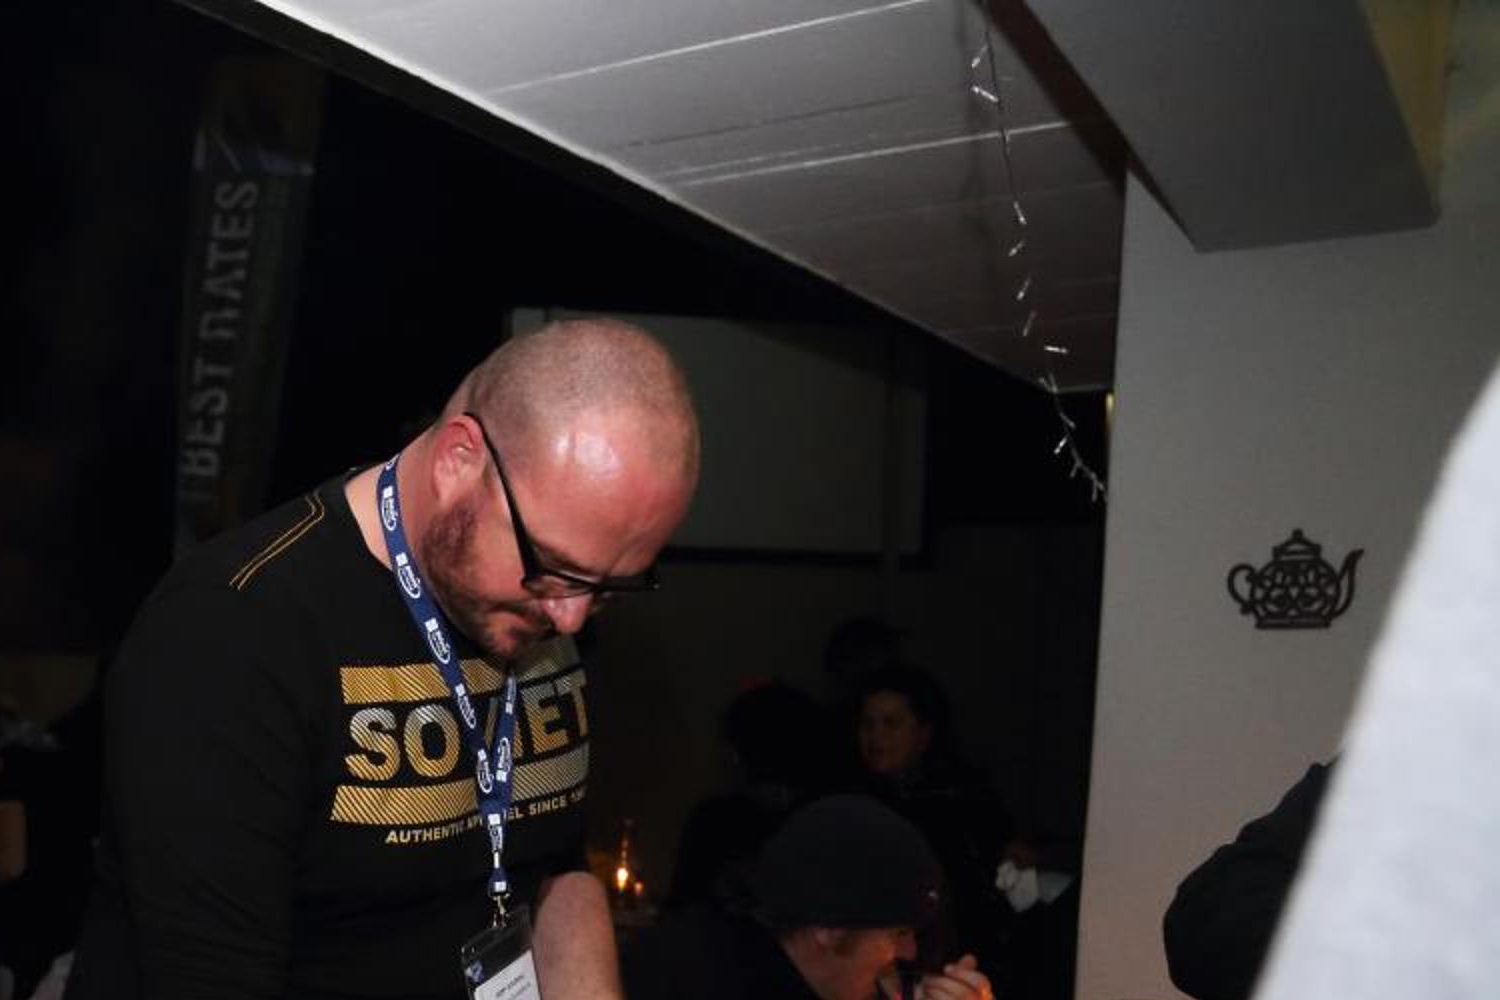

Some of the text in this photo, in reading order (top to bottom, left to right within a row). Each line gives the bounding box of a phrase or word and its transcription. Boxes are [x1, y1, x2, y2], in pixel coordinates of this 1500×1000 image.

[181, 180, 261, 478] BEST RATES
[528, 796, 568, 817] SINCE
